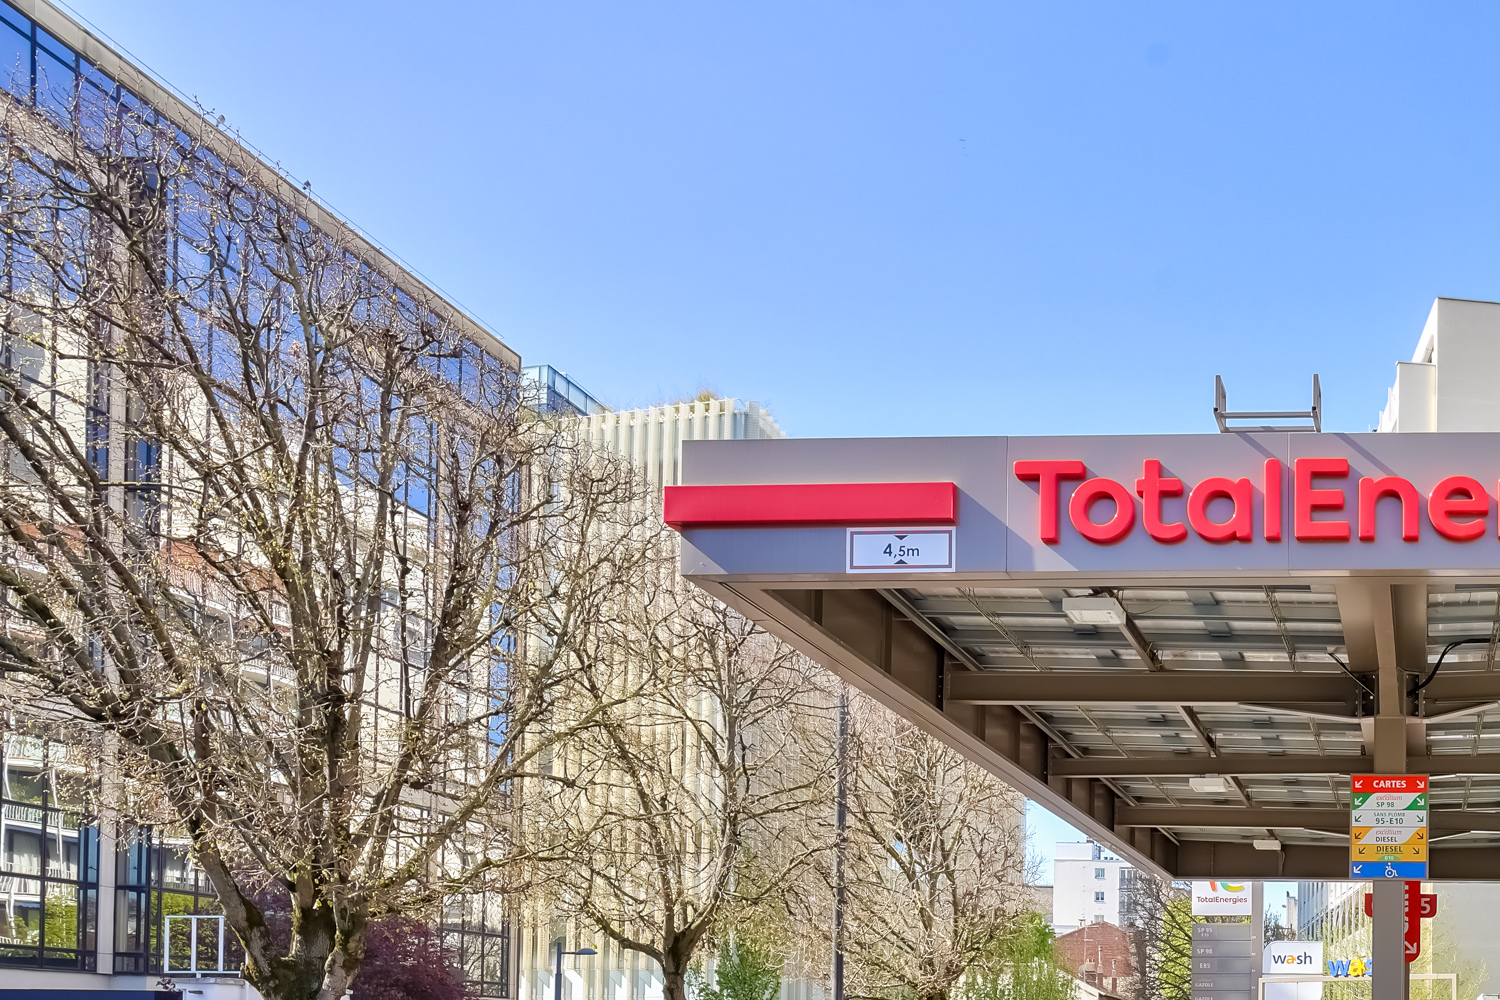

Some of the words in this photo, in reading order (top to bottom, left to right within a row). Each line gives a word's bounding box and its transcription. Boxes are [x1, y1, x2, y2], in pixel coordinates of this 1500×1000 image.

[882, 542, 921, 560] 4,5m
[1373, 780, 1406, 788] CARTES
[1196, 896, 1248, 905] TotalEnergies
[1420, 897, 1431, 914] 5
[1272, 952, 1313, 965] wash
